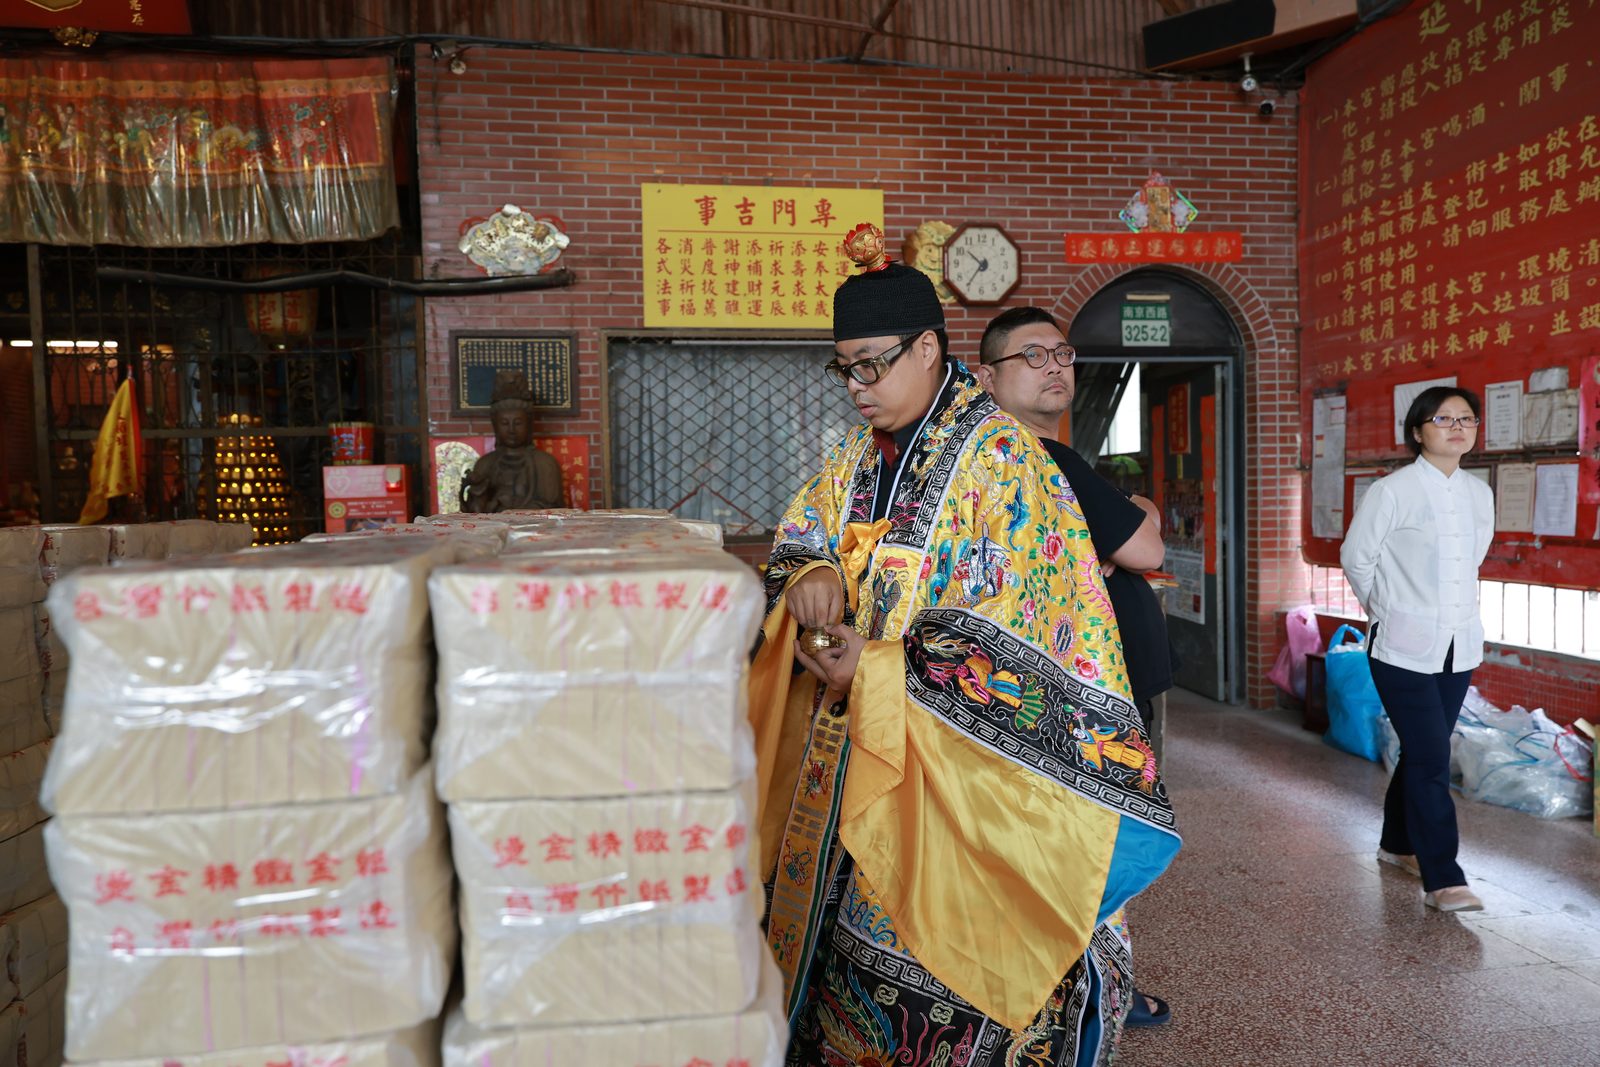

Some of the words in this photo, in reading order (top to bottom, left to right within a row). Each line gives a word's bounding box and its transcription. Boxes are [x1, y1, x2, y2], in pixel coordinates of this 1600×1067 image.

[965, 237, 973, 246] 11
[977, 234, 987, 243] 12
[956, 247, 965, 256] 10
[1000, 247, 1006, 256] 2
[953, 260, 960, 268] 9
[656, 237, 673, 317] 各式法事
[1123, 306, 1168, 319] 南京西路
[1124, 325, 1168, 342] 325之2
